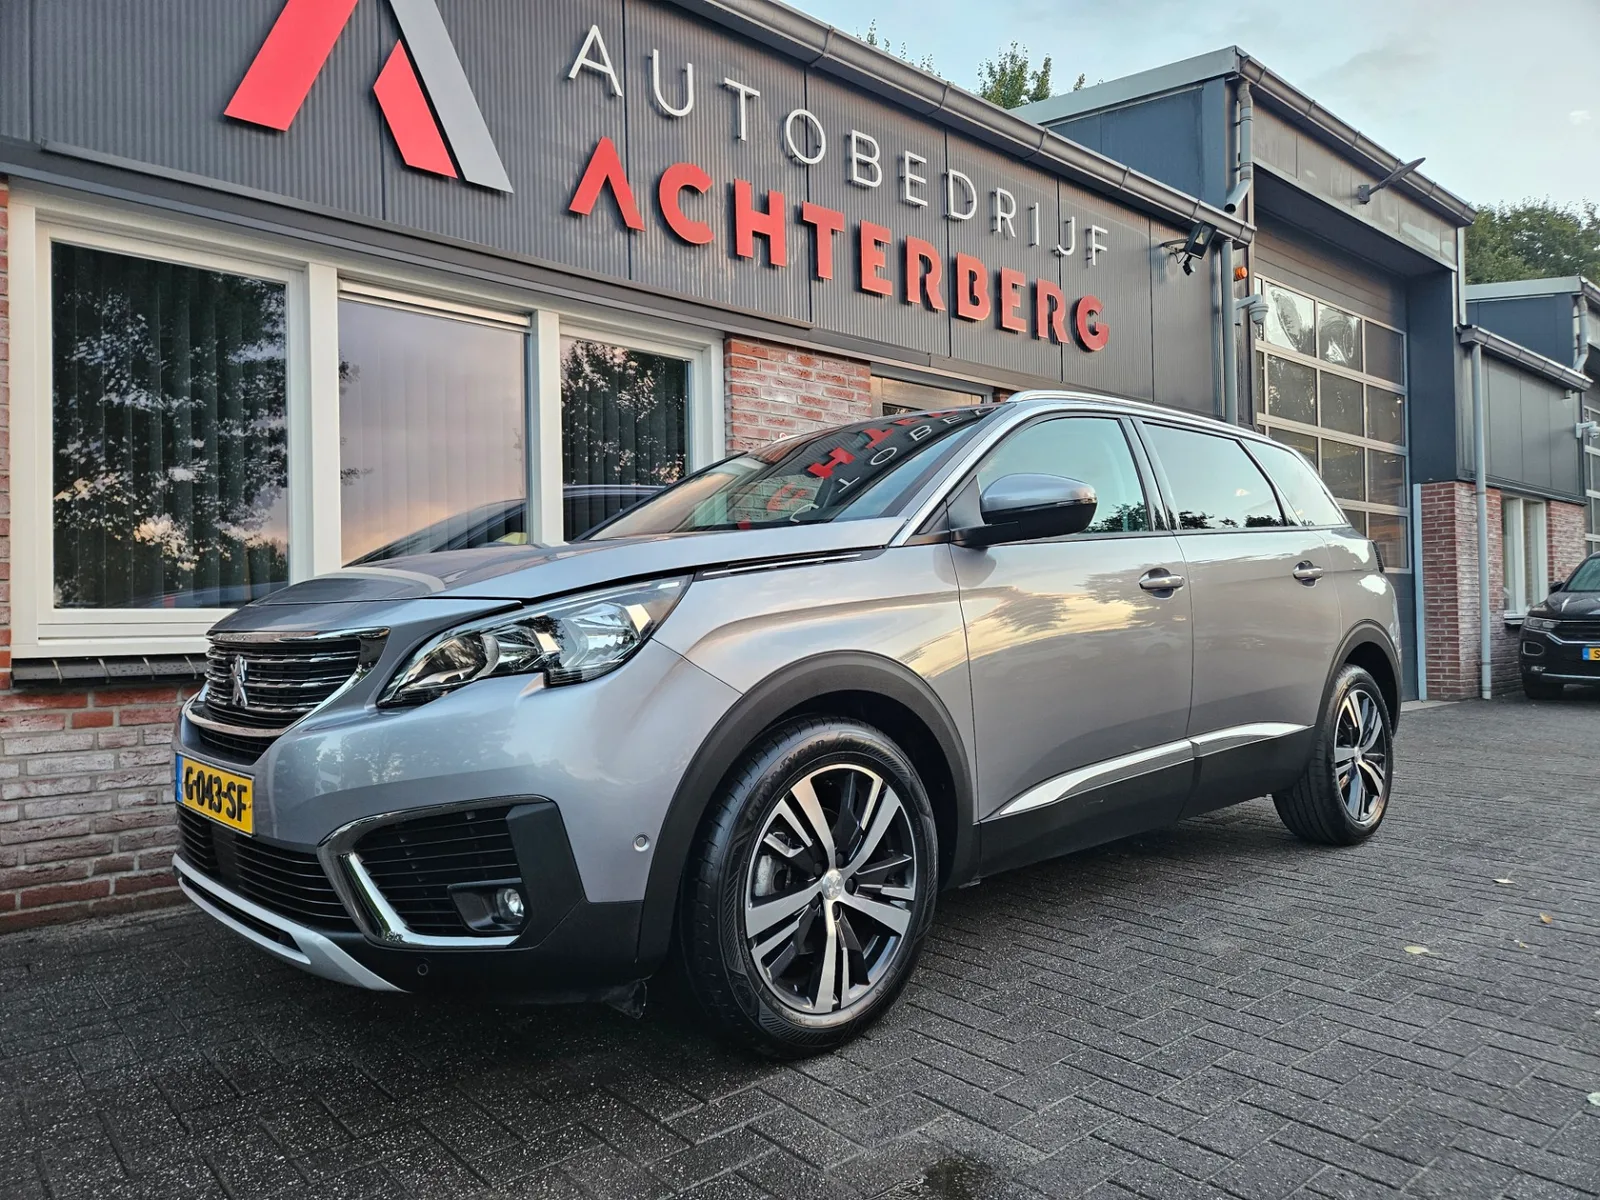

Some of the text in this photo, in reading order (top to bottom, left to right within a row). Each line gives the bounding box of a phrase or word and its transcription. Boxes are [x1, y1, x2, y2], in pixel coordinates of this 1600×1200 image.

[568, 25, 1109, 267] AUTOBEDRIJF
[569, 136, 1109, 352] ACHTERBERG
[185, 766, 248, 822] G-043-SF
